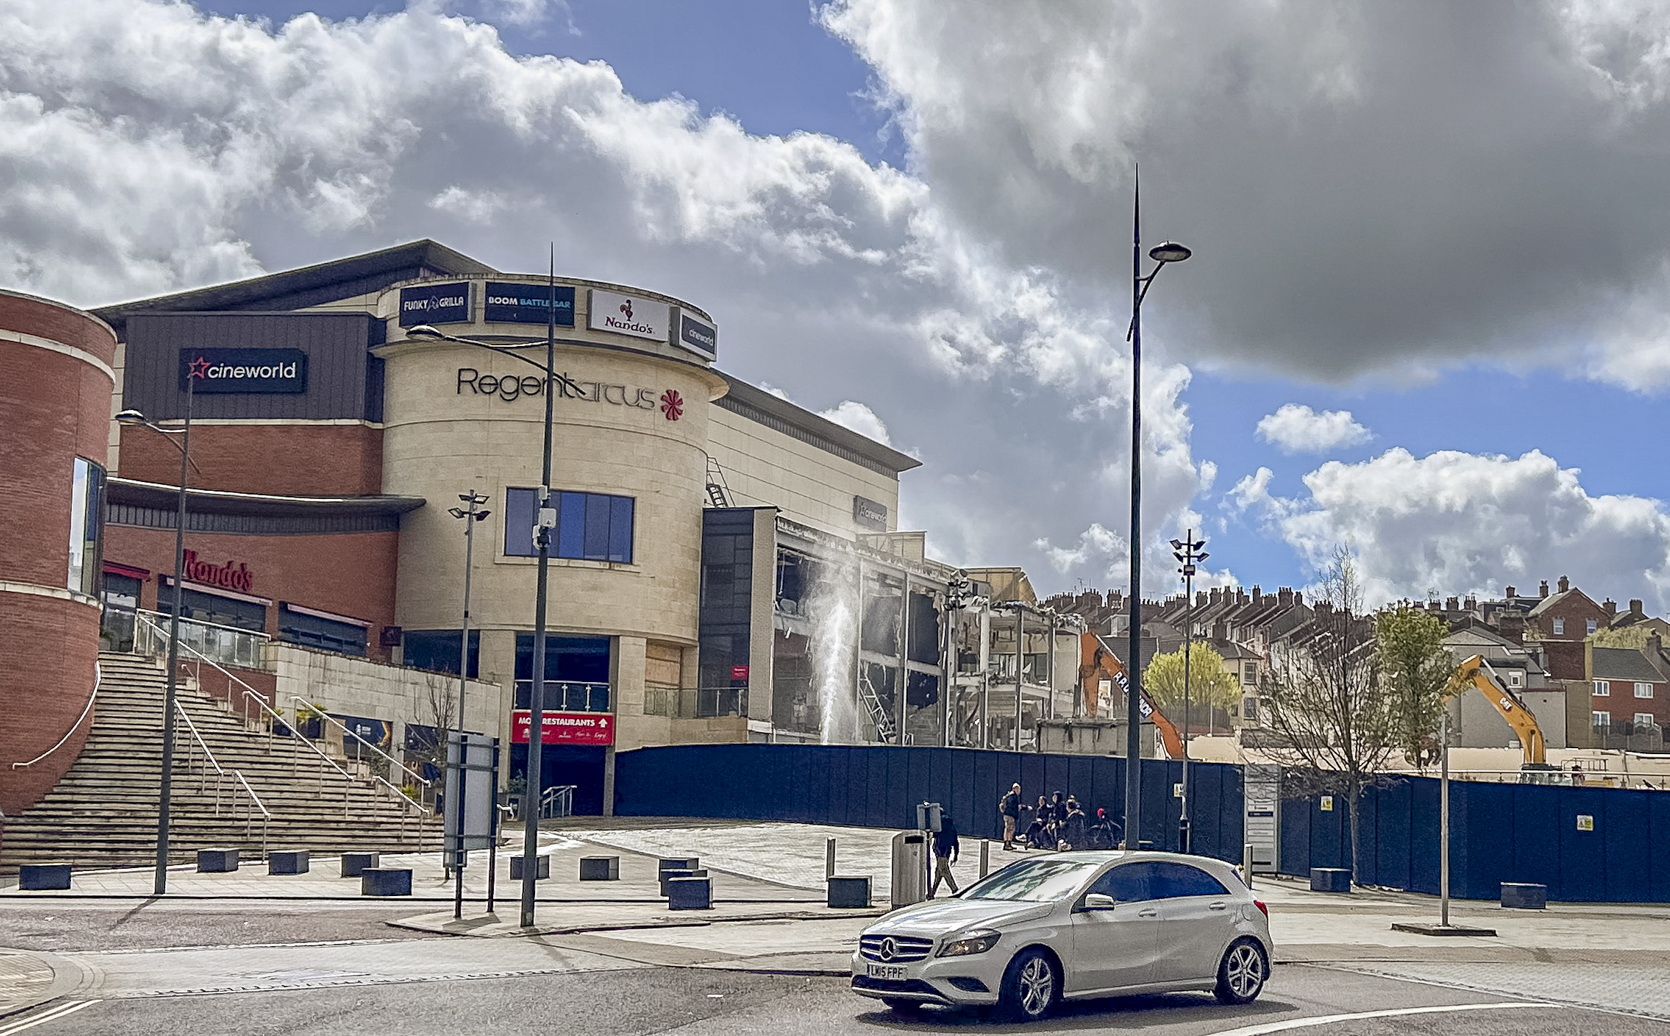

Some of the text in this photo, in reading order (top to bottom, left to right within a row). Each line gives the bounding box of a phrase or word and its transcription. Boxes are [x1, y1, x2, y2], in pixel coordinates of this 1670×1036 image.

[404, 296, 464, 312] FUNKY GRILLA
[488, 296, 518, 305] BOOM
[520, 298, 550, 307] BATTLE
[605, 316, 653, 334] Nando's
[207, 362, 296, 379] cineworld
[182, 548, 252, 592] Nando's
[1500, 697, 1512, 710] CAT
[541, 717, 595, 727] RESTAURANTS
[888, 967, 903, 978] FPF
